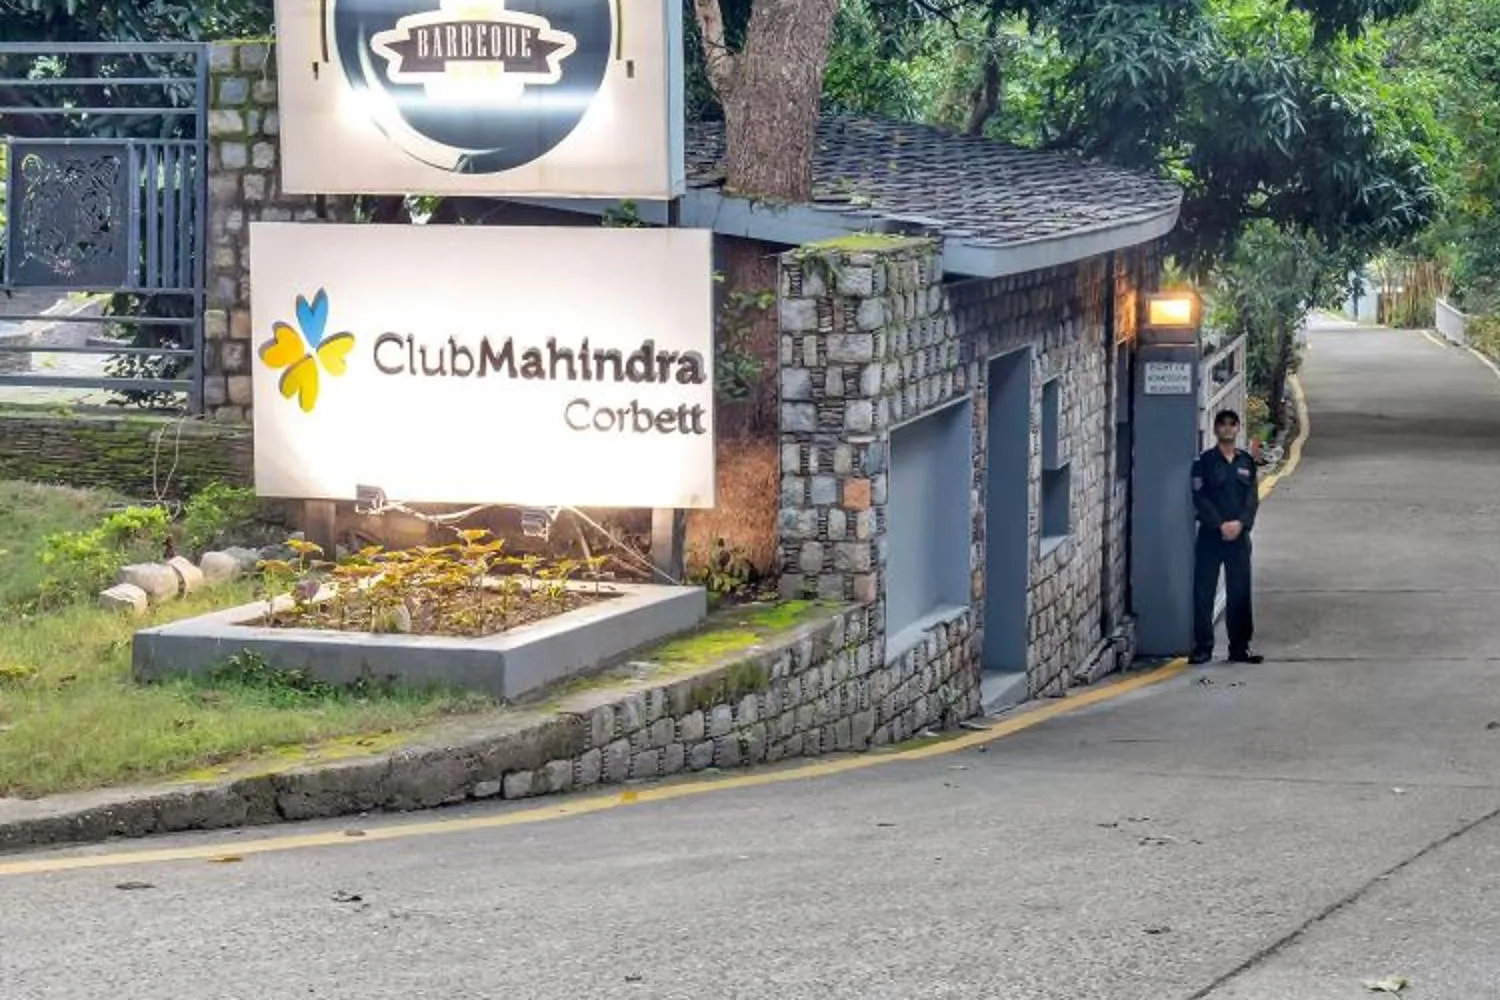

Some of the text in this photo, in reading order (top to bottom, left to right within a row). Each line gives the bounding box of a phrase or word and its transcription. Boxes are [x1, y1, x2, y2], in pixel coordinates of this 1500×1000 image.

[417, 23, 532, 60] BARBEQUE
[373, 332, 706, 384] ClubMahindra
[564, 398, 706, 435] Corbett
